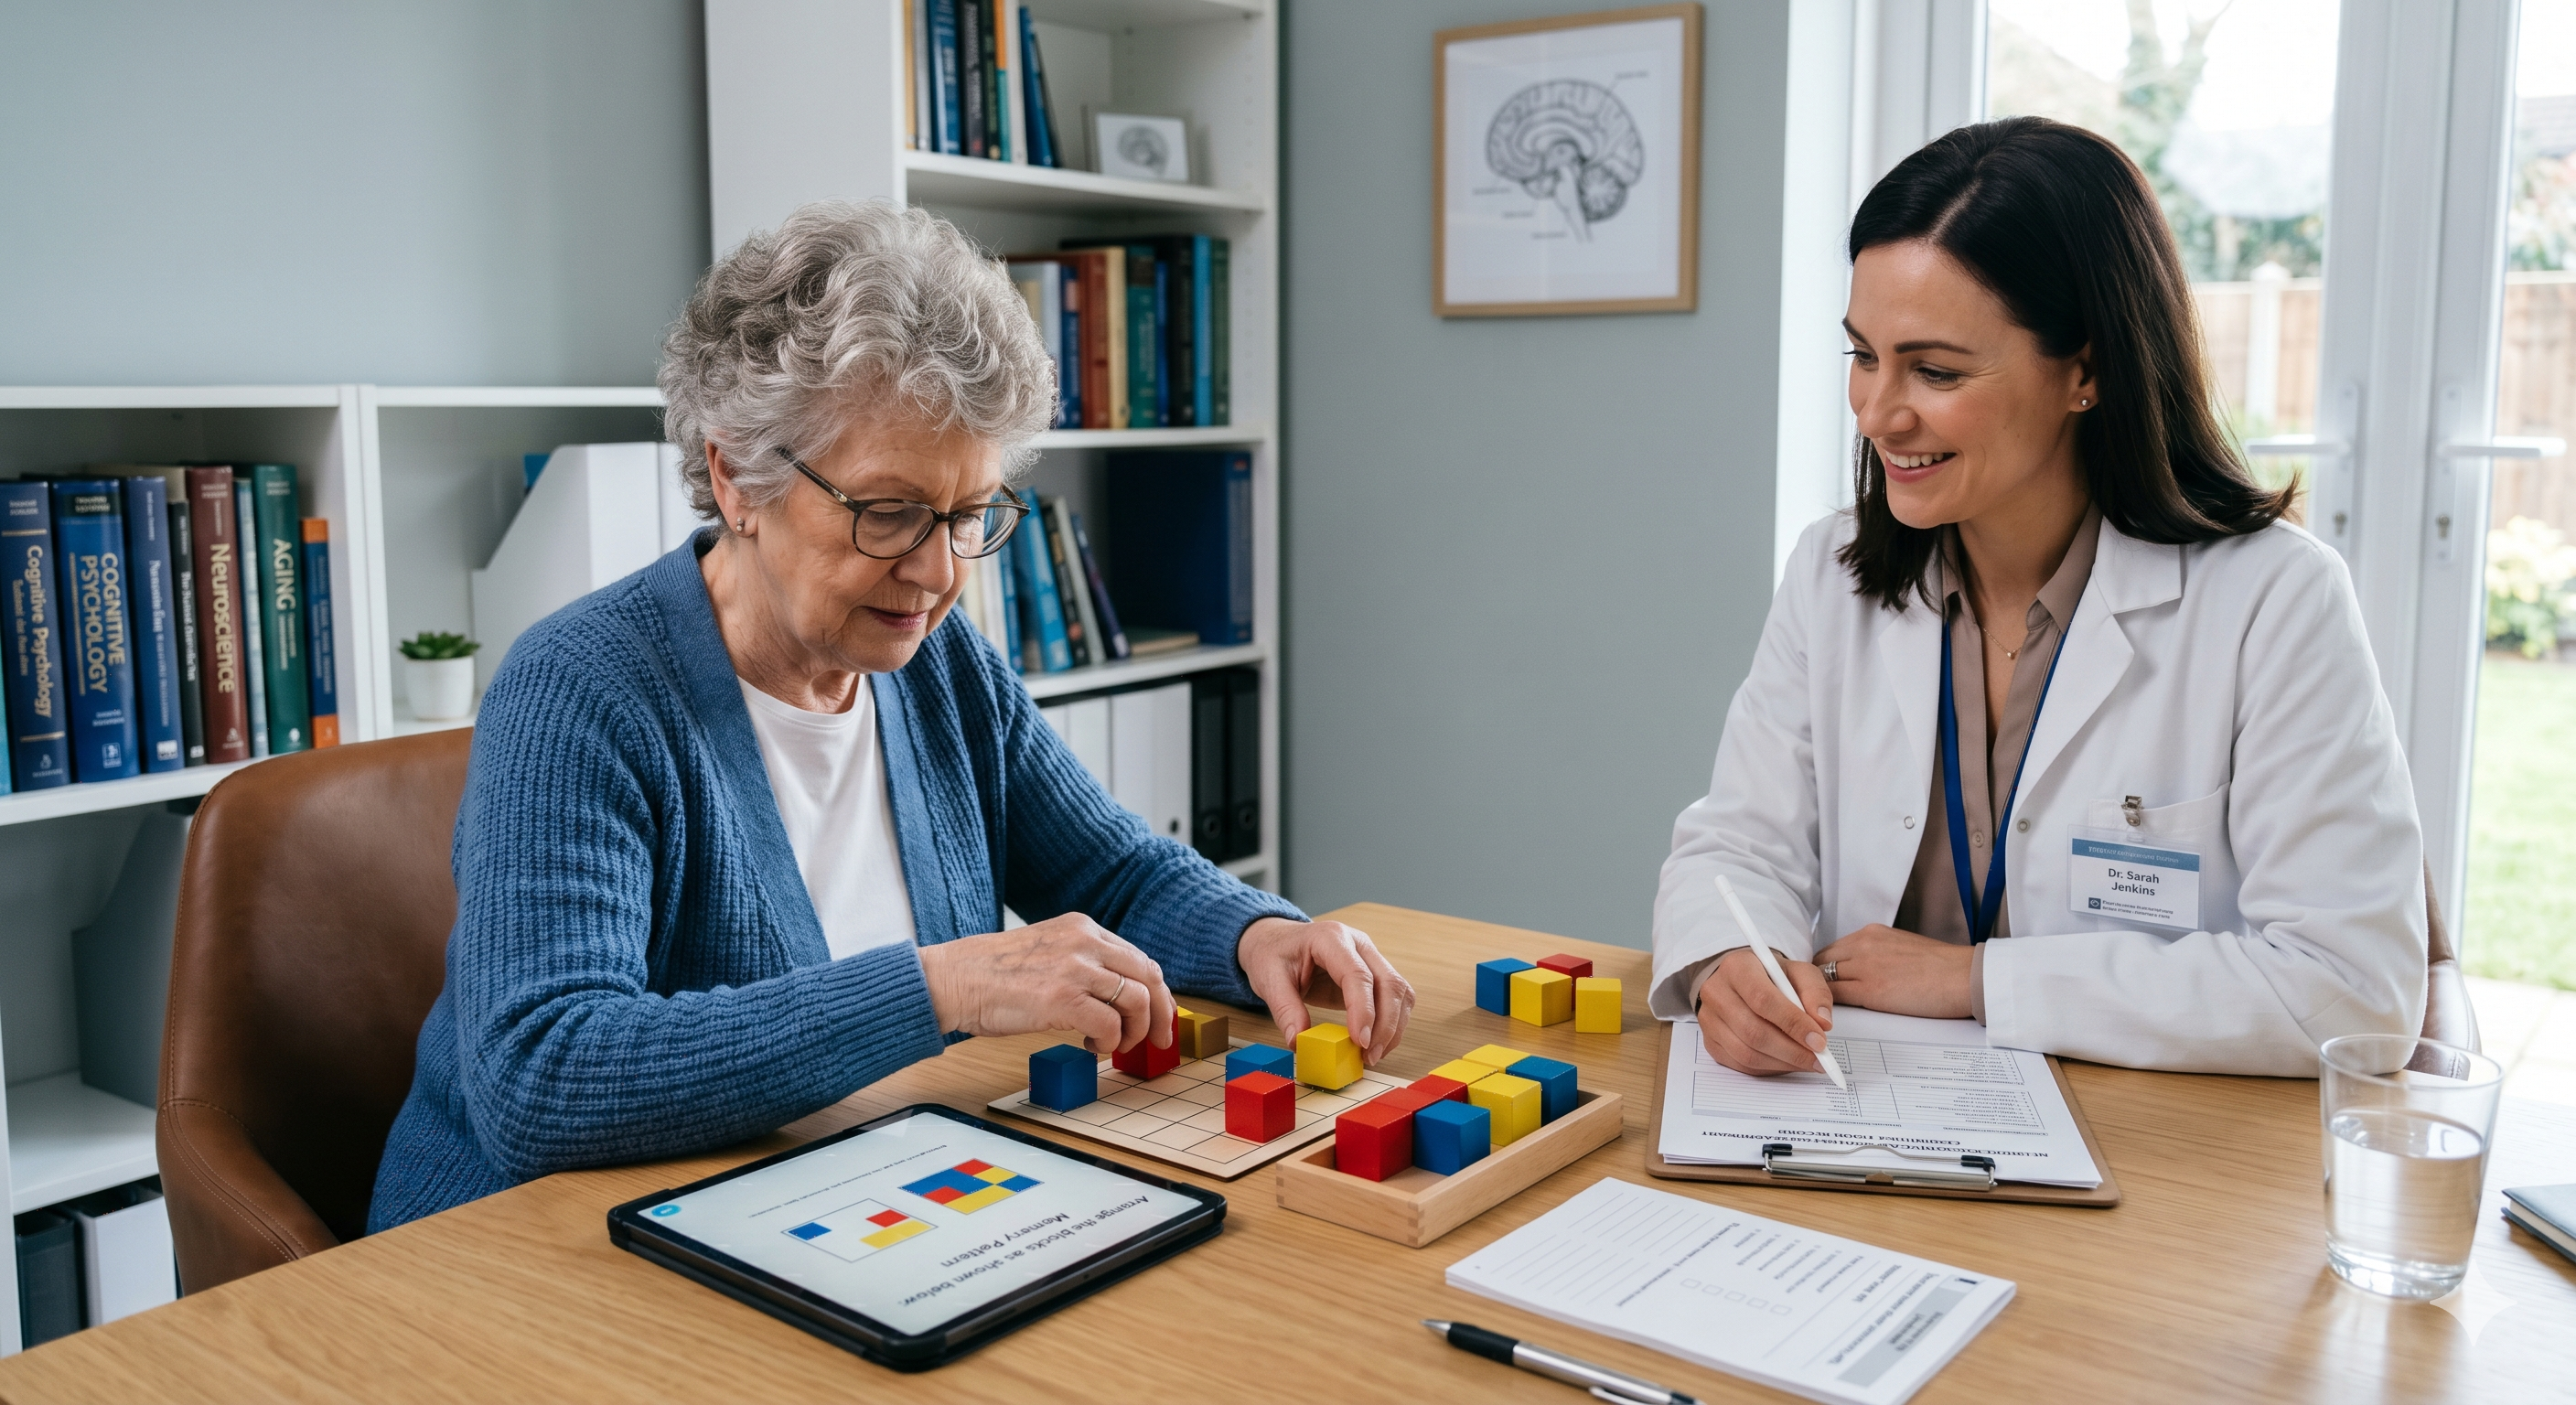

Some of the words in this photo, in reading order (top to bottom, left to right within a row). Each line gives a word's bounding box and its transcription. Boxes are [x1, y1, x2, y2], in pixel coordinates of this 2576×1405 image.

[25, 545, 47, 624] Cognitive
[274, 538, 297, 611] AGING
[80, 554, 108, 694] PSYCHOLOGY
[101, 552, 126, 666] COGNITIVE
[210, 543, 236, 694] Neuroscience
[31, 627, 54, 718] Psychology
[2108, 868, 2123, 879] Dr.
[2127, 871, 2160, 884] Sarah
[2111, 882, 2155, 896] Jenkins
[1026, 1228, 1076, 1251] blocks
[1071, 1218, 1097, 1232] the
[957, 1260, 1005, 1283] shown
[1004, 1249, 1025, 1260] as
